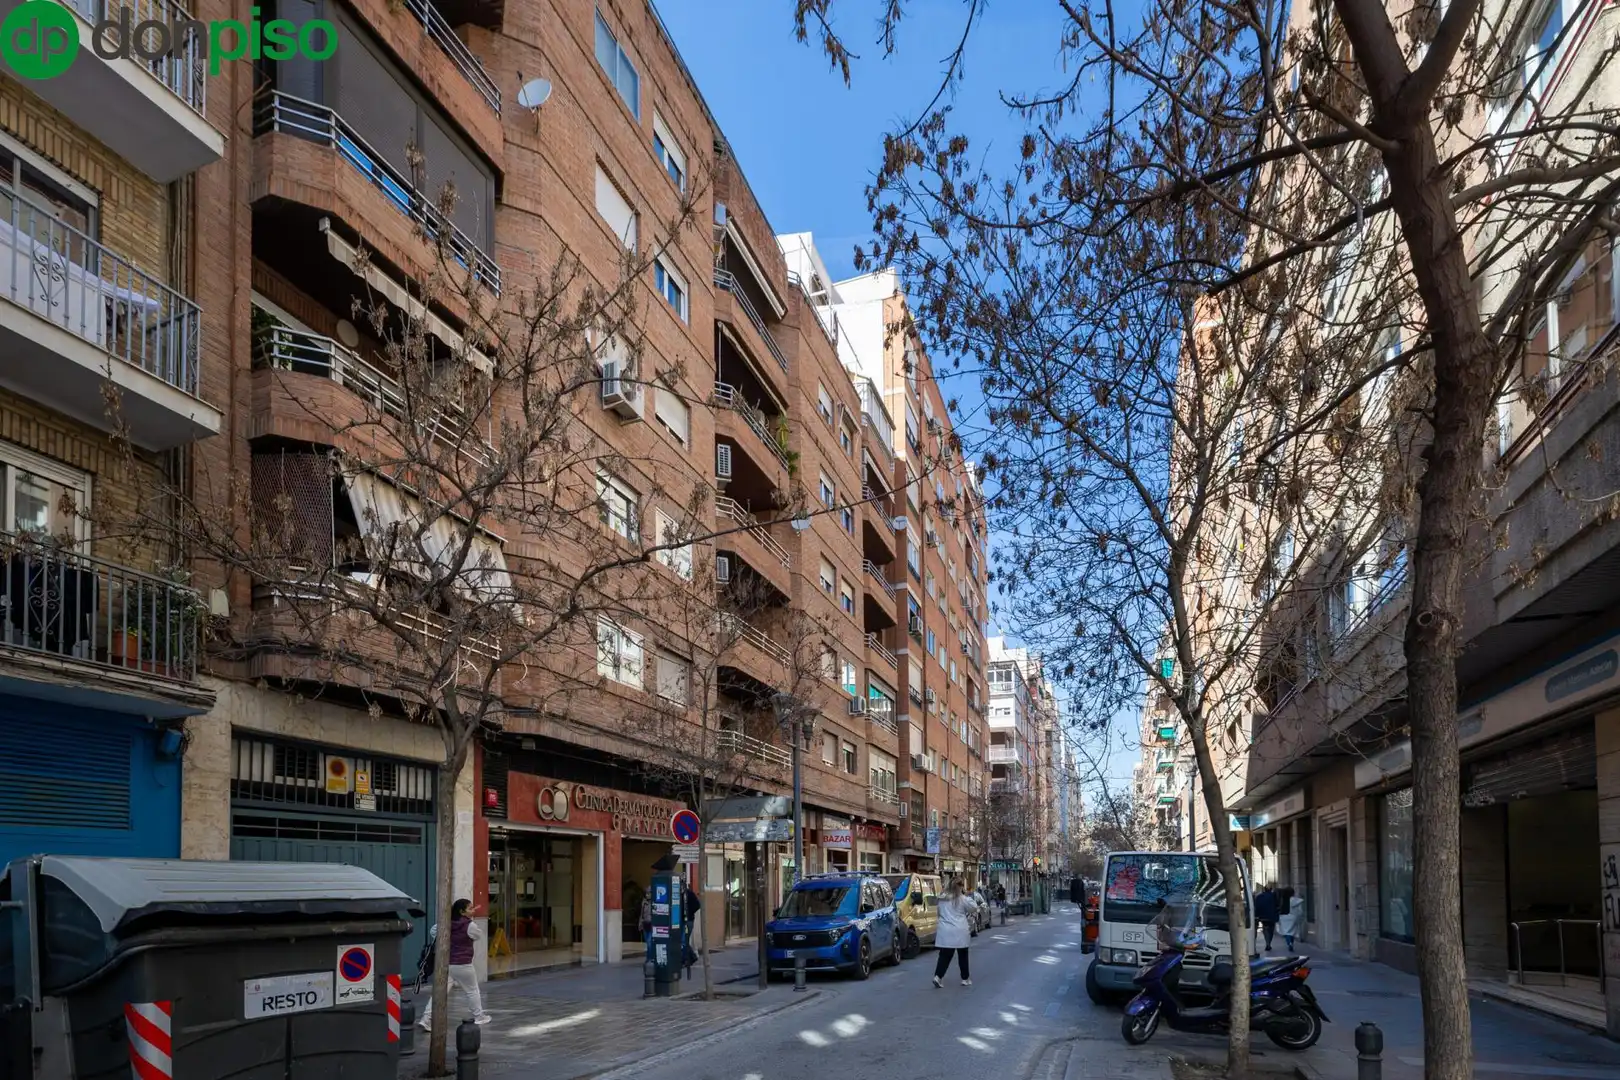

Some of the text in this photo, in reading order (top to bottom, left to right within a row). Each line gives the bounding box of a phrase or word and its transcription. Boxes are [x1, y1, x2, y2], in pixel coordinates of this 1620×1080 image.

[613, 813, 667, 835] GRANAD
[823, 835, 851, 843] BAZAR
[1125, 933, 1141, 941] SP
[262, 991, 317, 1012] RESTO
